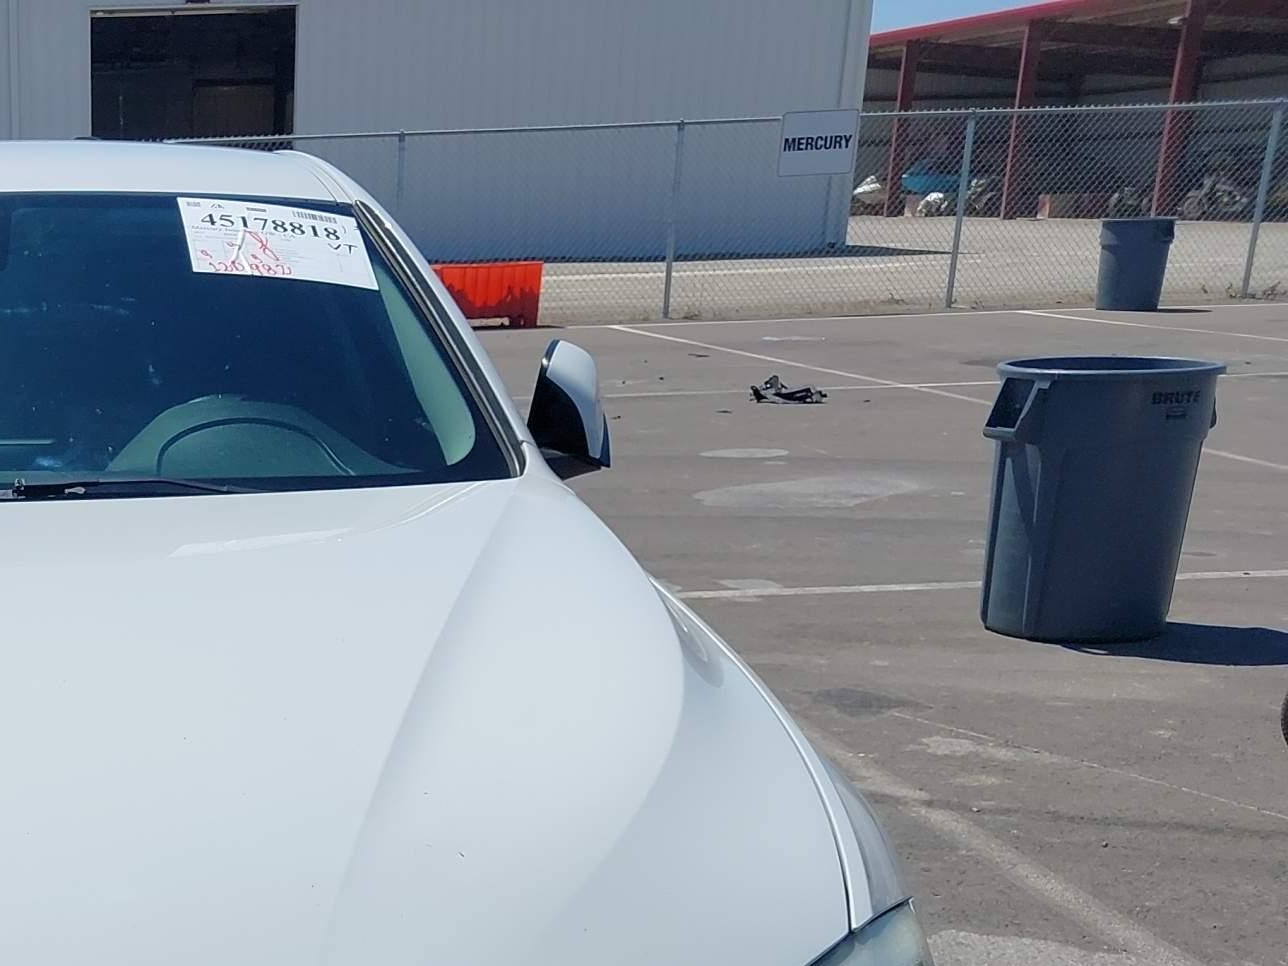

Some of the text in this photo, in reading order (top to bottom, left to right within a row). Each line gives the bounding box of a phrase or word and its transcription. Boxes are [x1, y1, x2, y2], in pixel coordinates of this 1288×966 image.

[783, 134, 853, 152] MERCURY
[201, 213, 341, 241] 45178818
[1151, 390, 1201, 405] BRUTE
